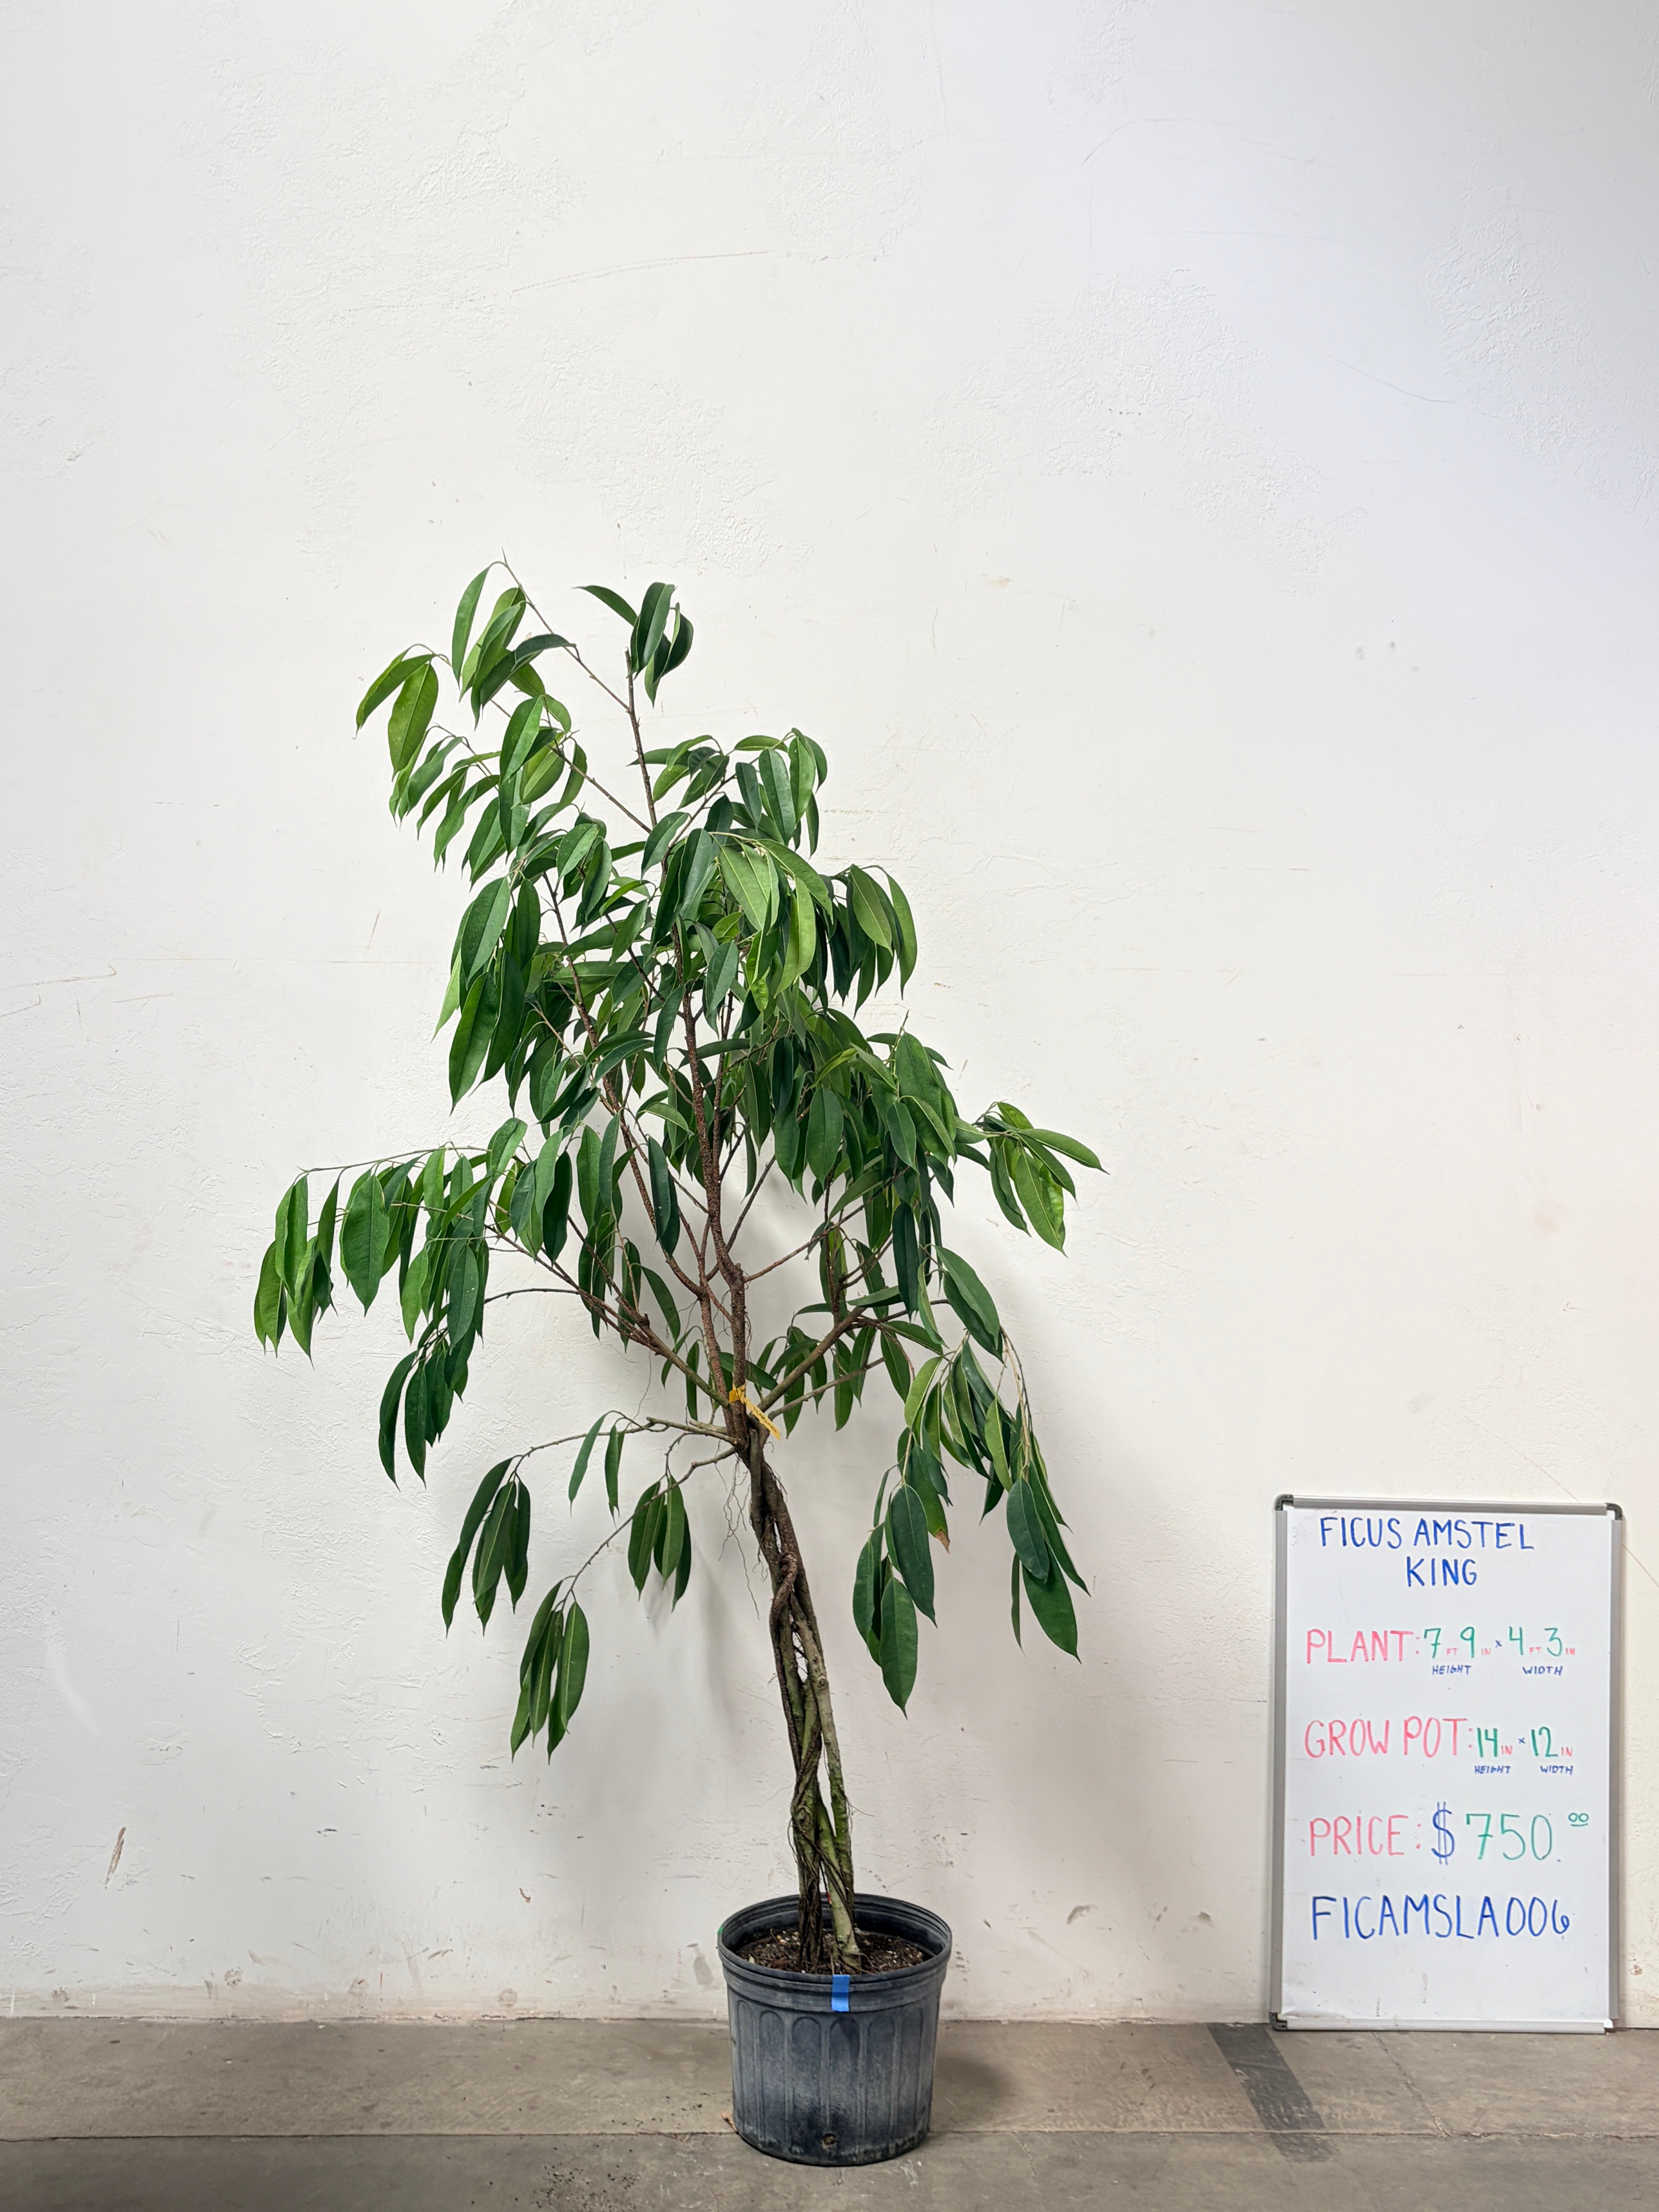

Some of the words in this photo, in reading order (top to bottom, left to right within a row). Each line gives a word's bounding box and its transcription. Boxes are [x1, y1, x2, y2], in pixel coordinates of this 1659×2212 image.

[1319, 1516, 1403, 1549] FICUS
[1413, 1517, 1535, 1550] AMSTEL
[1406, 1556, 1477, 1588] KING
[1306, 1628, 1420, 1664] PLANT:
[1423, 1628, 1442, 1659] 7
[1460, 1626, 1475, 1658] 9
[1509, 1626, 1524, 1656] 4
[1544, 1627, 1563, 1657] 3
[1432, 1664, 1472, 1675] HEIGHT
[1522, 1665, 1563, 1676] WIDTH
[1304, 1719, 1390, 1759] GROW
[1403, 1716, 1472, 1758] POT:
[1476, 1727, 1498, 1758] 14
[1530, 1726, 1559, 1758] 12
[1474, 1765, 1511, 1774] HEIGHT
[1539, 1765, 1574, 1775] WIDTH
[1309, 1814, 1421, 1856] PRICE:
[1312, 1893, 1570, 1941] FICAMSLA006
